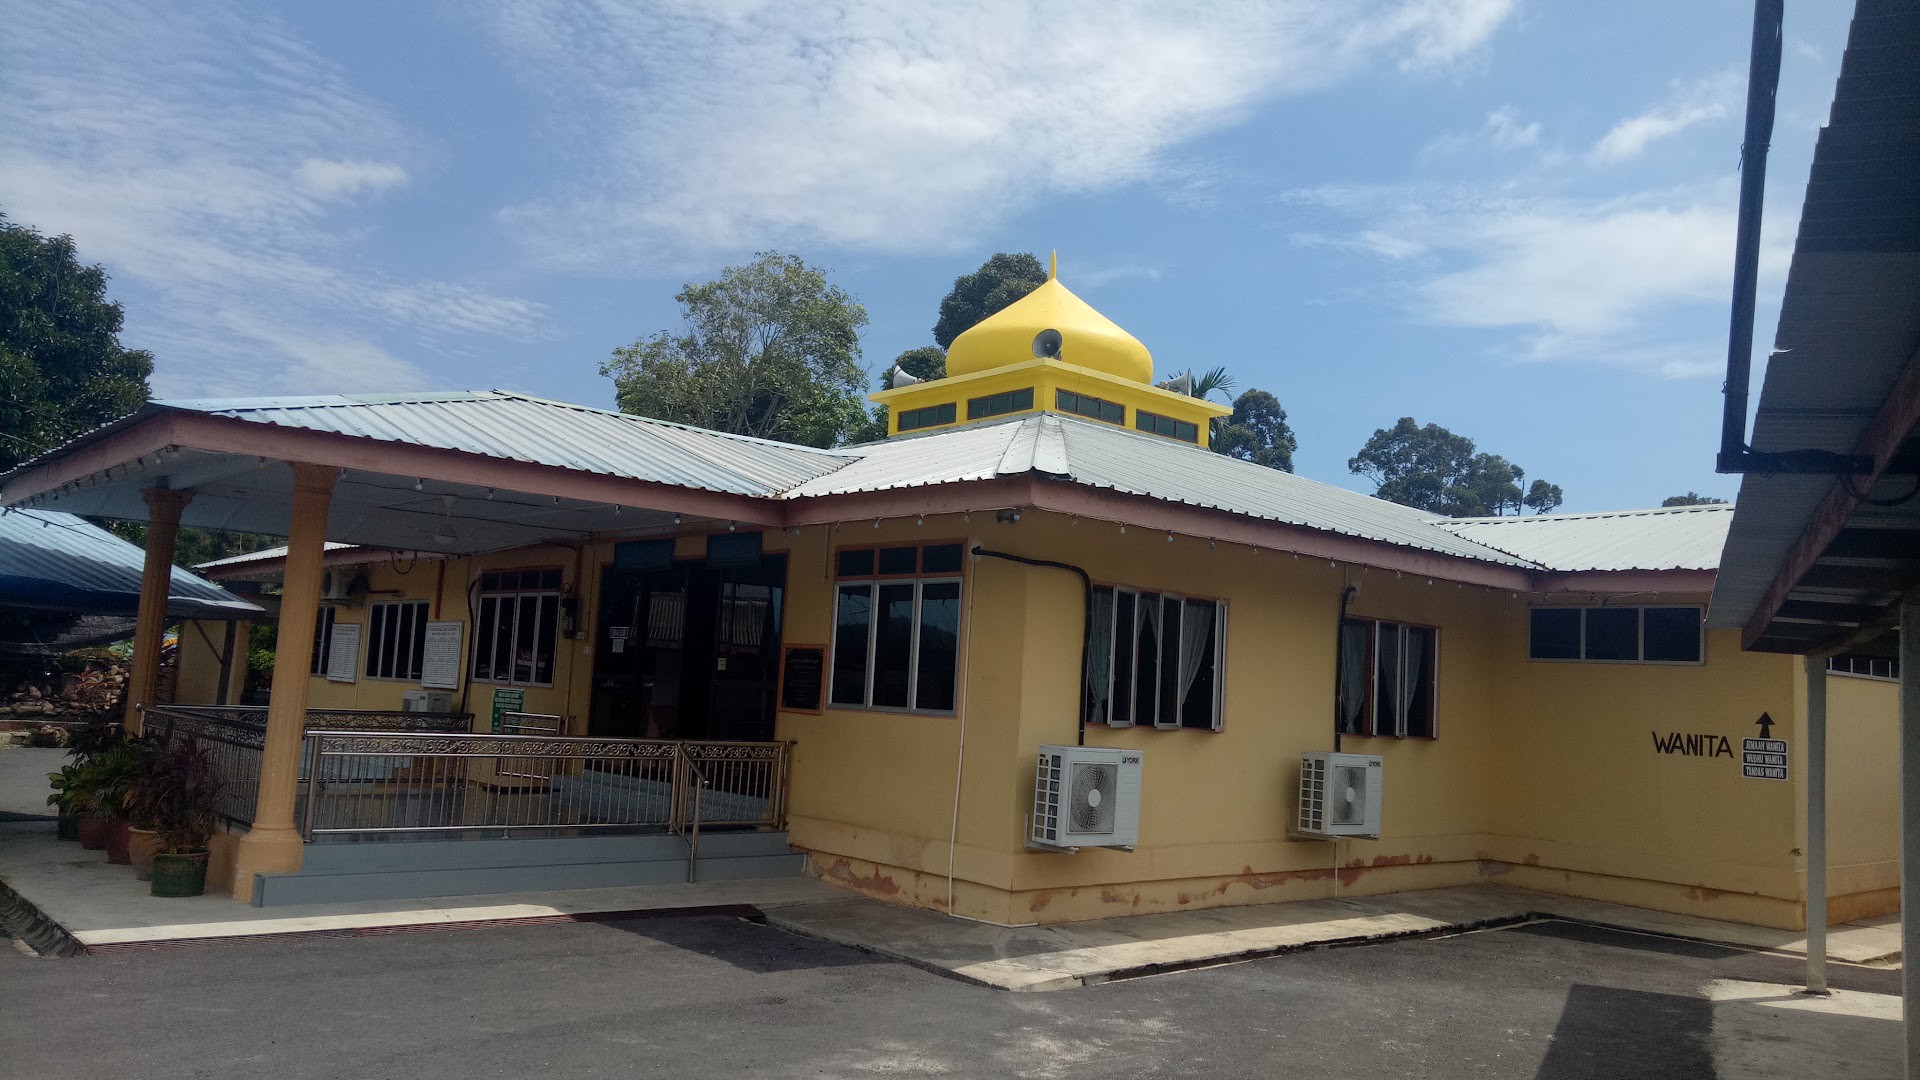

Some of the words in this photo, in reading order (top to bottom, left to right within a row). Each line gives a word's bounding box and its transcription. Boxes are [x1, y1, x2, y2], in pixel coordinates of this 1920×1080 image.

[1651, 731, 1735, 759] WANITA
[1765, 741, 1785, 752] WANITA
[1764, 754, 1784, 765] WANITA
[1745, 766, 1765, 777] TANDAS
[1765, 767, 1784, 779] WANITA
